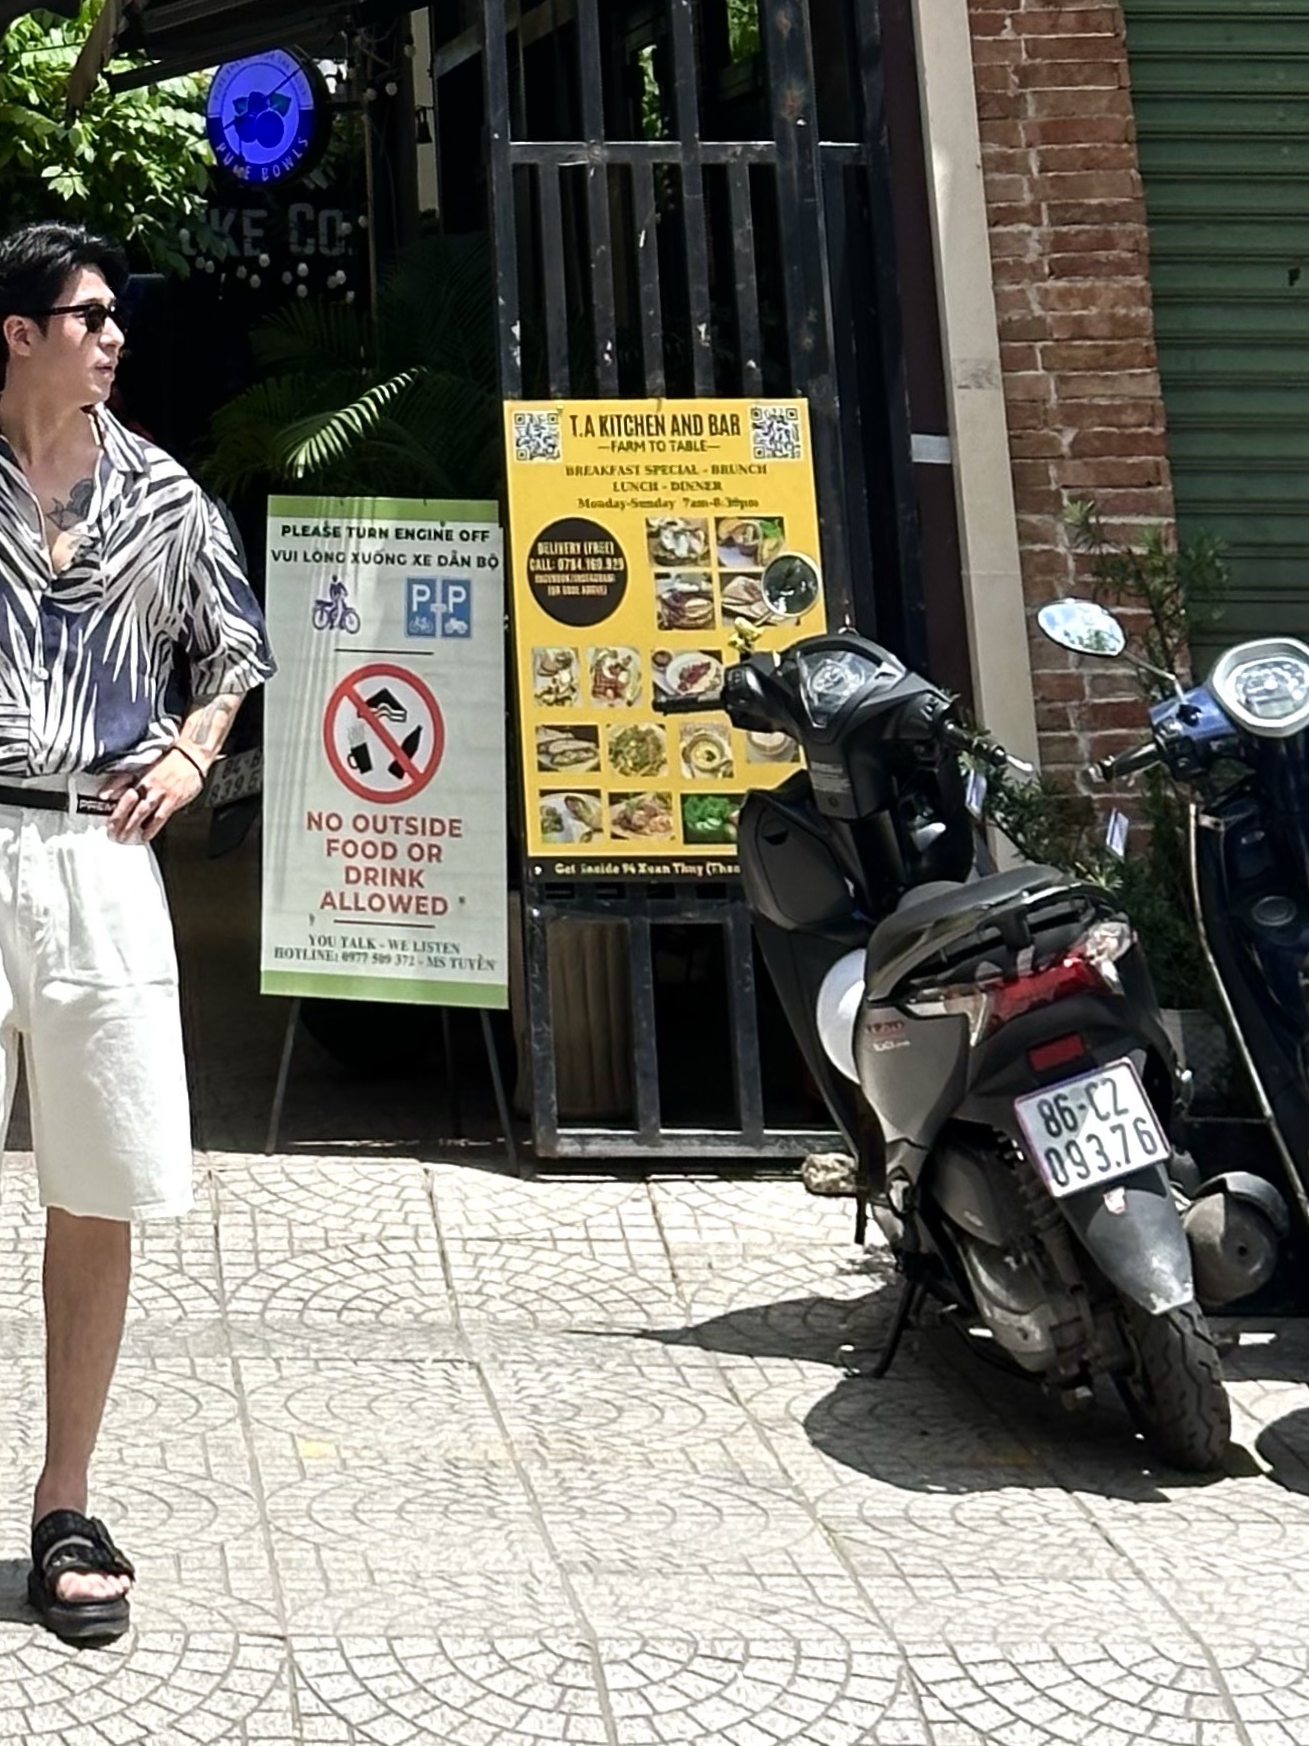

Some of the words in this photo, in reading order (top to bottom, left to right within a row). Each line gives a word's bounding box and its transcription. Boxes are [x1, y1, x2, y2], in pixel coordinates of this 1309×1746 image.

[261, 136, 309, 182] BOWLS
[569, 414, 596, 438] T.A
[599, 413, 666, 438] KITCHEN
[671, 413, 704, 437] AND
[709, 412, 741, 437] BAR
[649, 440, 665, 452] TO
[565, 464, 641, 476] BREAKFAST
[644, 464, 700, 476] SPECIAL
[710, 464, 768, 475] BRUNCH
[613, 481, 659, 492] LUNCH
[670, 481, 723, 491] DINNER
[281, 524, 341, 539] PLEASE
[346, 526, 389, 540] TURN
[394, 528, 454, 542] ENGINE
[459, 529, 491, 543] OFF
[271, 550, 298, 563] VUI
[413, 554, 432, 567] XE
[476, 553, 500, 571] BỘ
[412, 584, 431, 612] P
[447, 585, 467, 613] P
[306, 811, 343, 832] NO
[352, 814, 463, 838] OUTSIDE
[326, 839, 397, 860] FOOD
[407, 842, 443, 863] OR
[344, 865, 425, 888] DRINK
[320, 891, 448, 916] ALLOWED
[308, 934, 337, 948] YOU
[340, 936, 377, 950] TALK
[387, 939, 409, 952] WE
[413, 941, 461, 954] LISTEN
[274, 947, 339, 962] HOTLINE:
[426, 956, 446, 968] MS
[1036, 1077, 1131, 1140] 86-C2
[1045, 1116, 1158, 1190] 093.76
